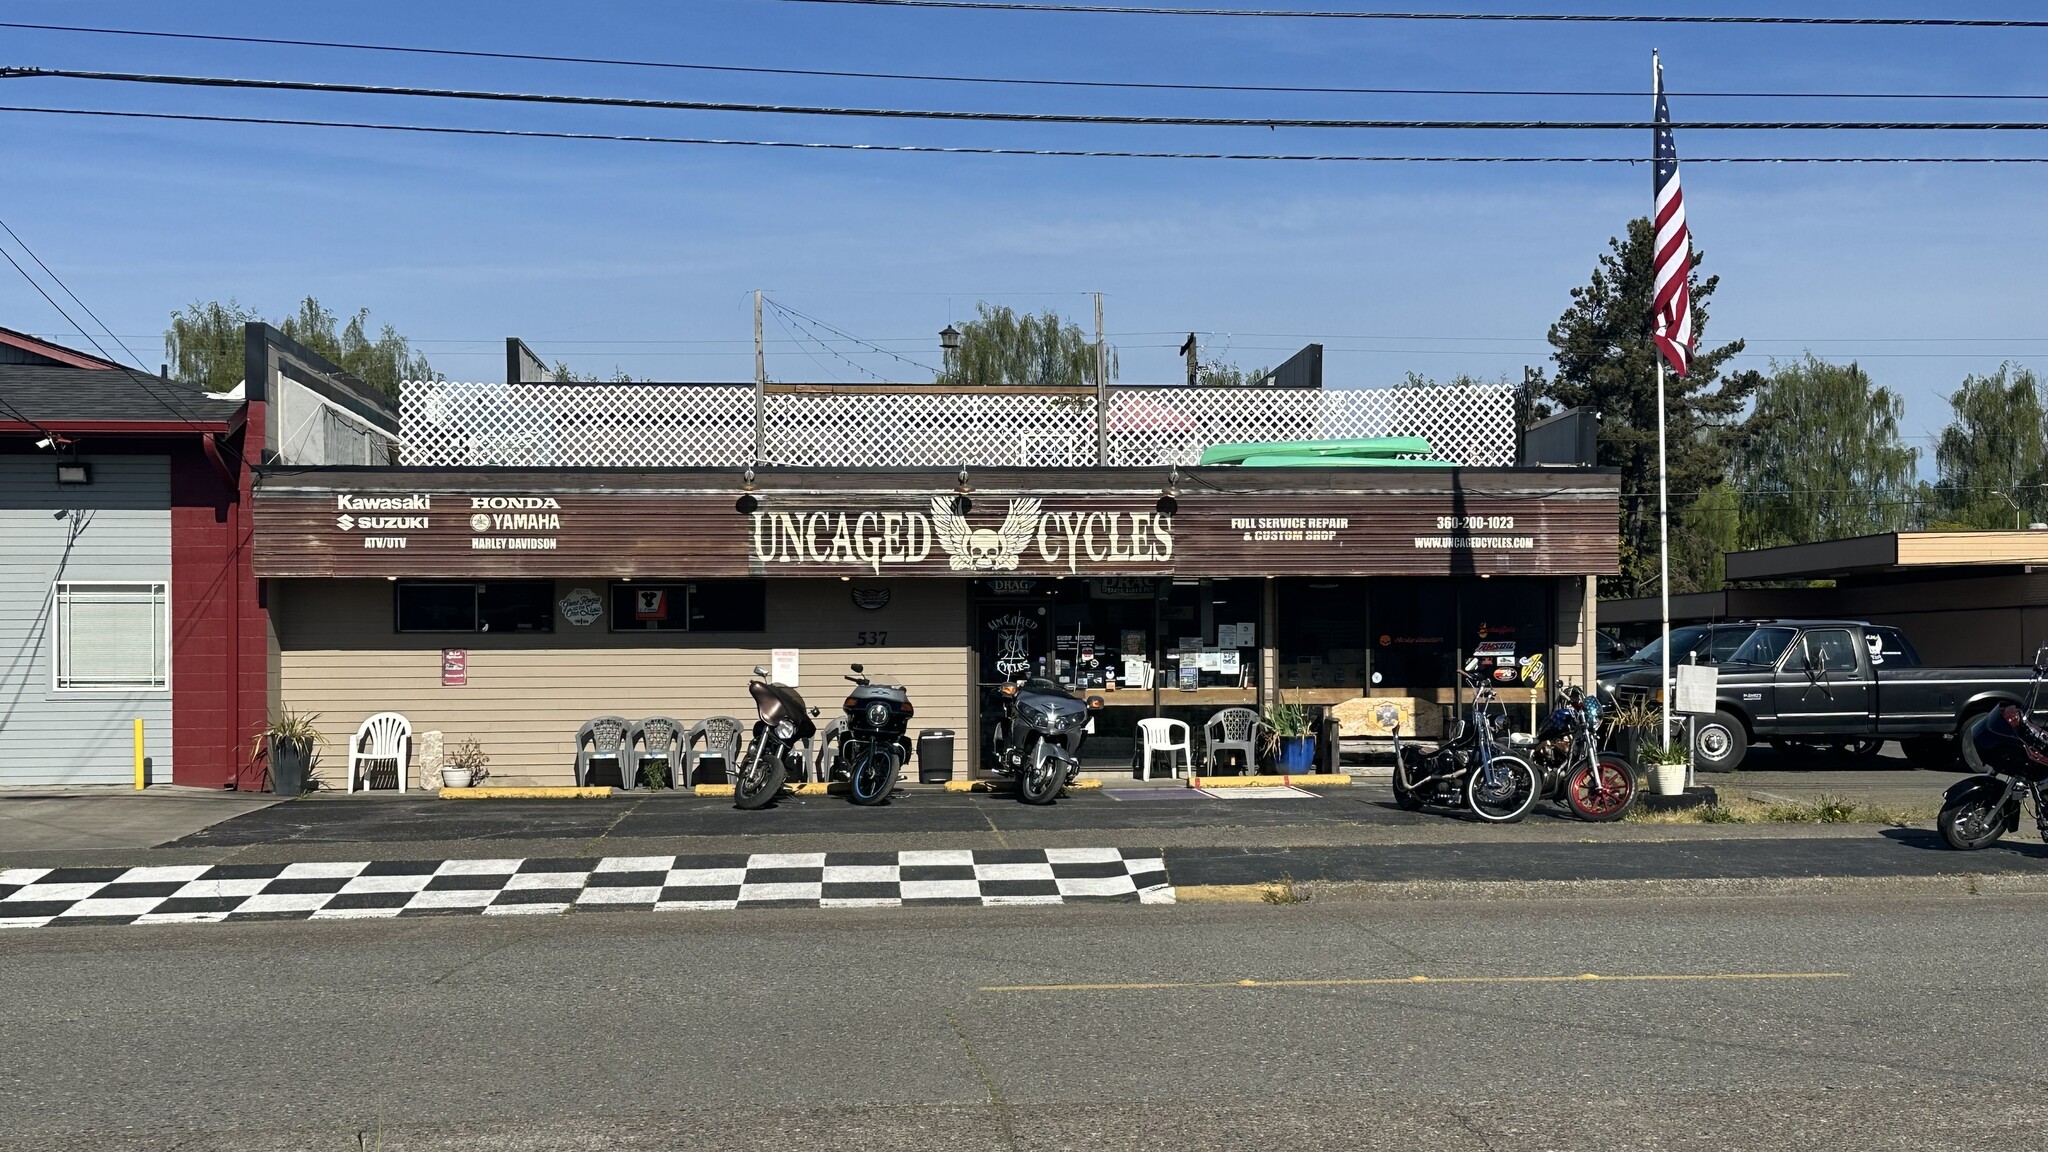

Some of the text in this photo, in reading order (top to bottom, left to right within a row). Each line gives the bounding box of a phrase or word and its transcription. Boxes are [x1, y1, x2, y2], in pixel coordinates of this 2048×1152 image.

[337, 494, 431, 510] Kawasaki
[470, 497, 561, 509] HONDA
[357, 516, 429, 529] SUZUKI
[492, 513, 561, 530] YAMAHA
[1231, 517, 1349, 529] FULL SERVICE REPAIR
[1436, 516, 1514, 529] 360-200-1023
[1243, 530, 1337, 541] & CUSTOM SHOP
[364, 537, 407, 549] ATV/UTV
[471, 538, 557, 550] HARLEY DAVIDSON
[753, 511, 1173, 575] UNCAGED CYCLES
[1414, 537, 1534, 549] WWW.UNCAGEDCYCLES.COM
[994, 580, 1029, 591] DRAG
[857, 631, 888, 646] 537
